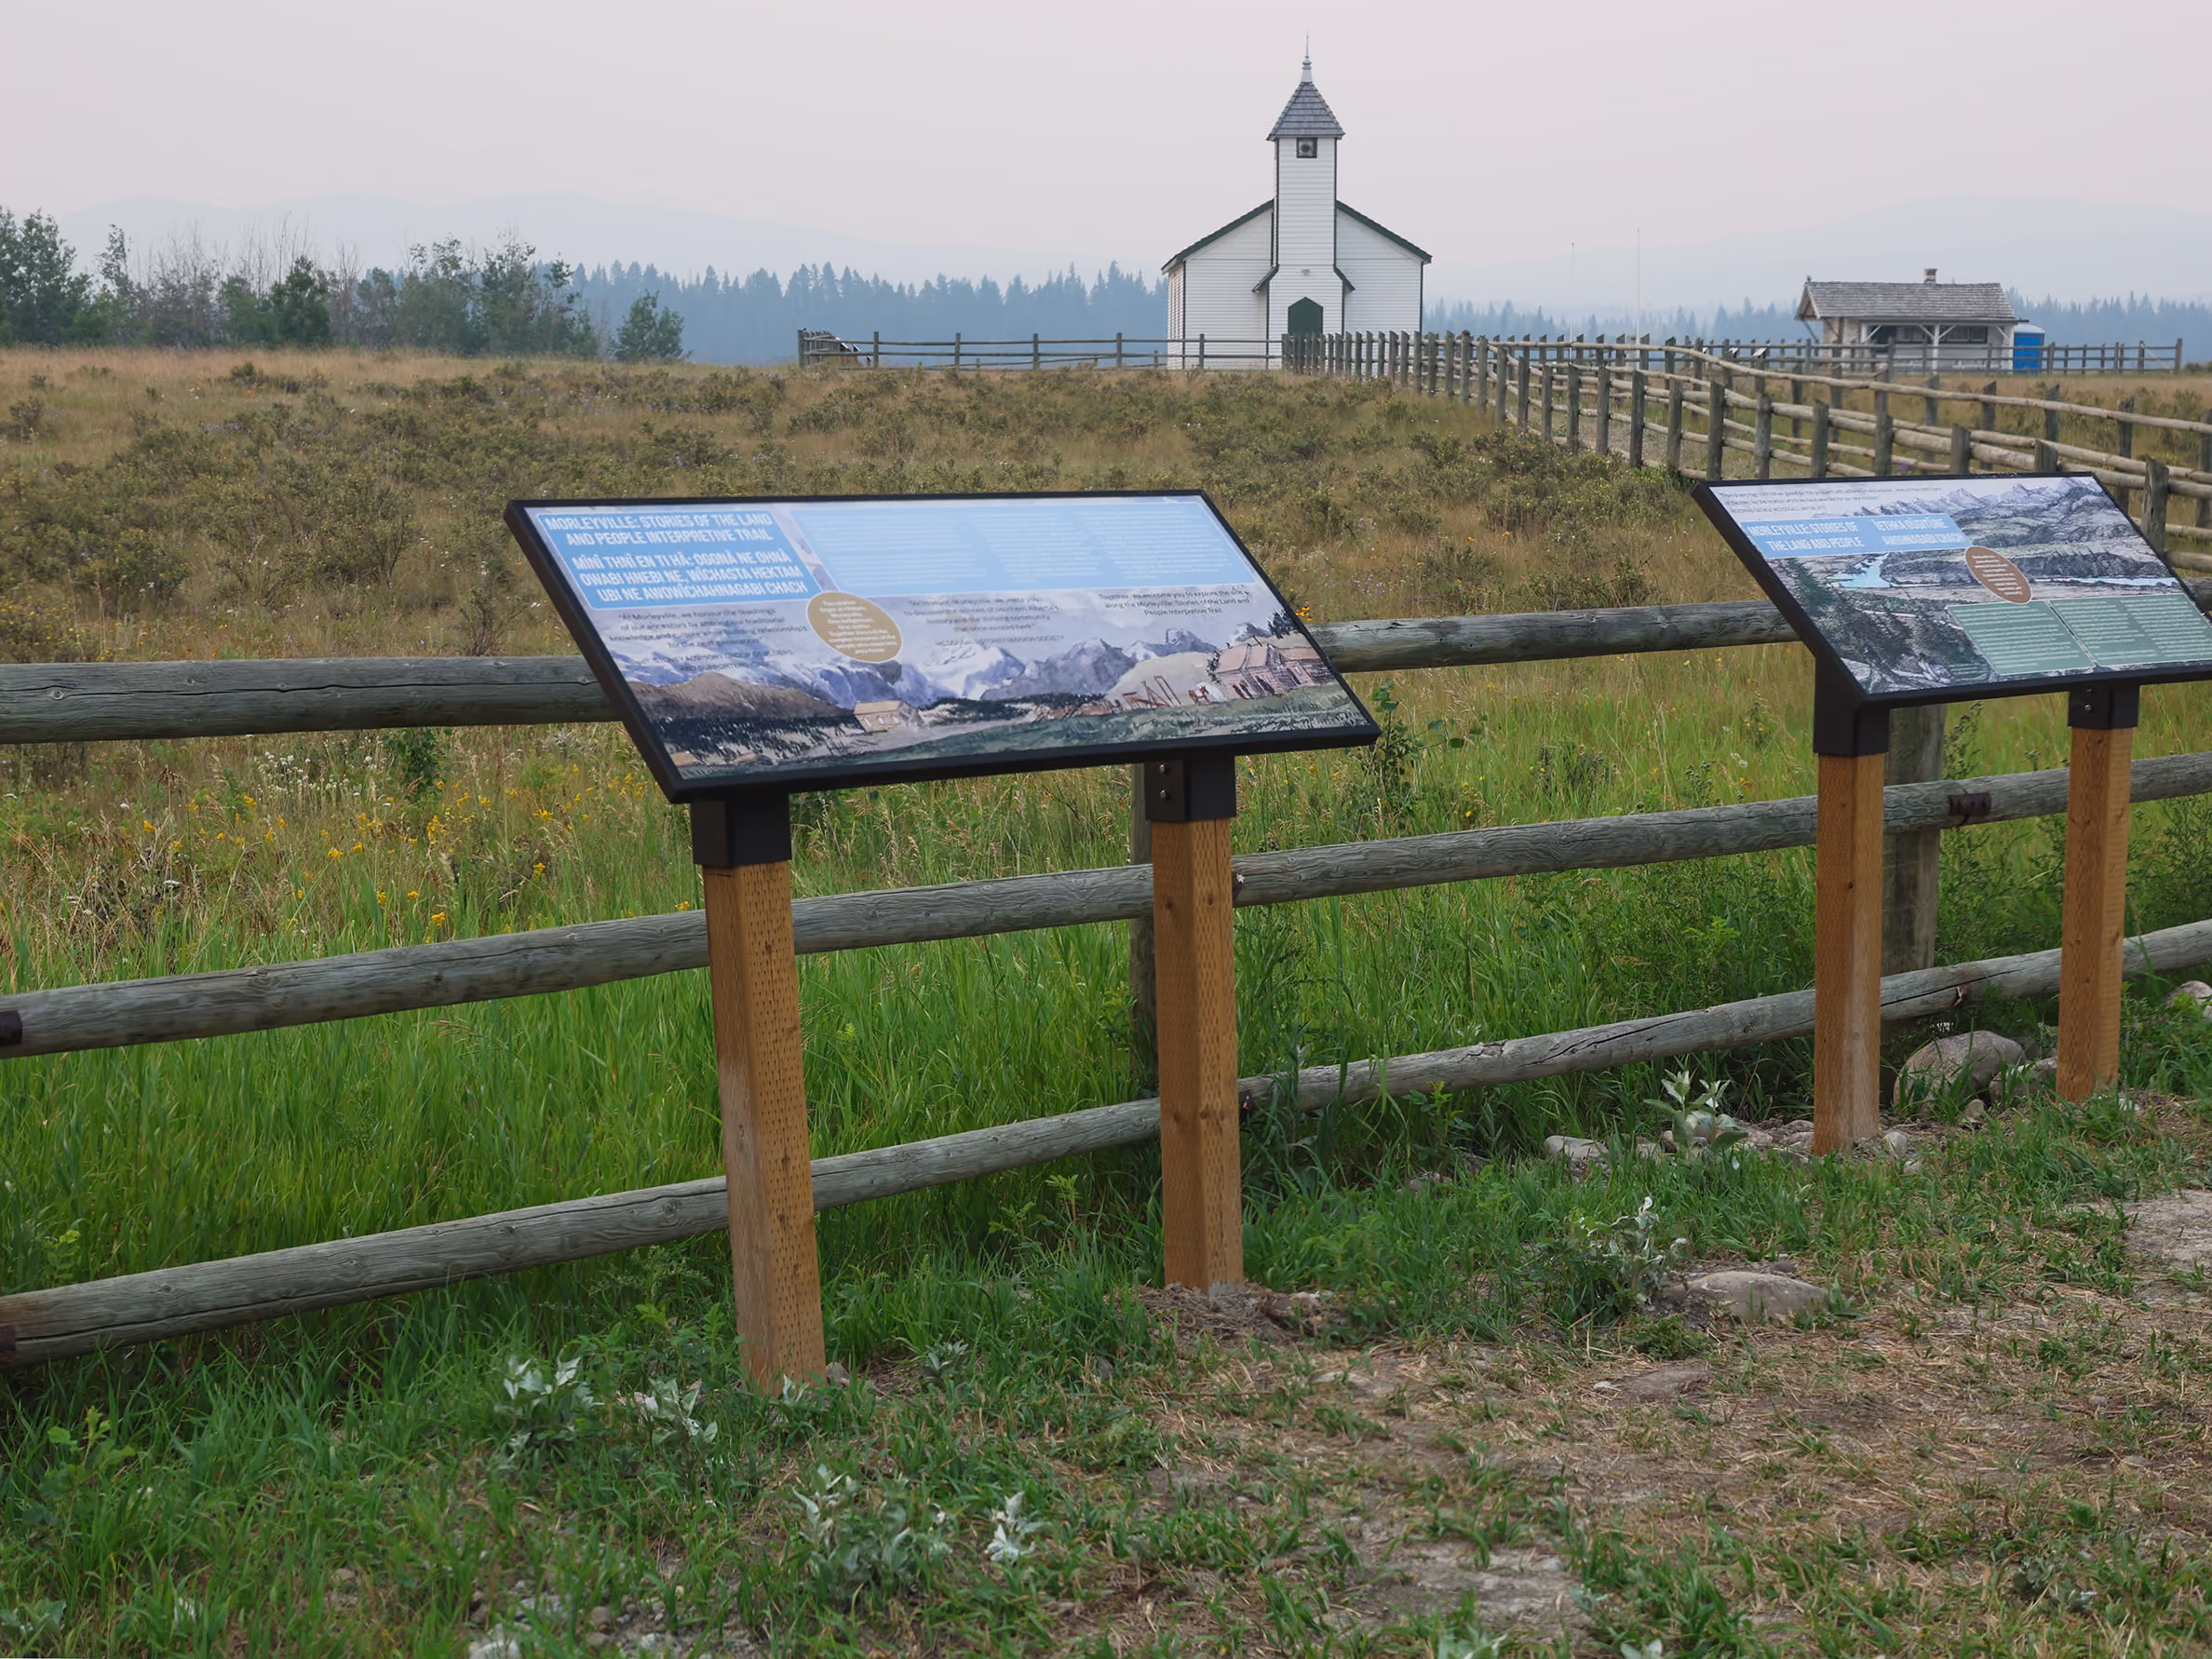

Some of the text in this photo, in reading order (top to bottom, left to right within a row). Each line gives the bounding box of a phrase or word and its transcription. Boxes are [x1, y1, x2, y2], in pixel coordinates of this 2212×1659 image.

[545, 513, 773, 530] MORLEYVILLE: STORIES OF THE LAND
[1747, 521, 1858, 536] MORLEYVILLE: STORIES OF
[566, 528, 775, 546] AND PEOPLE INTERPRETIVE TRAIL
[1765, 536, 1865, 551] THE LAND AND PEOPLE
[636, 555, 656, 568] EN
[735, 551, 753, 564] NE
[750, 565, 803, 579] HEKTAM
[597, 588, 623, 601] UBI
[622, 587, 643, 600] NE
[764, 580, 808, 595] CHACH
